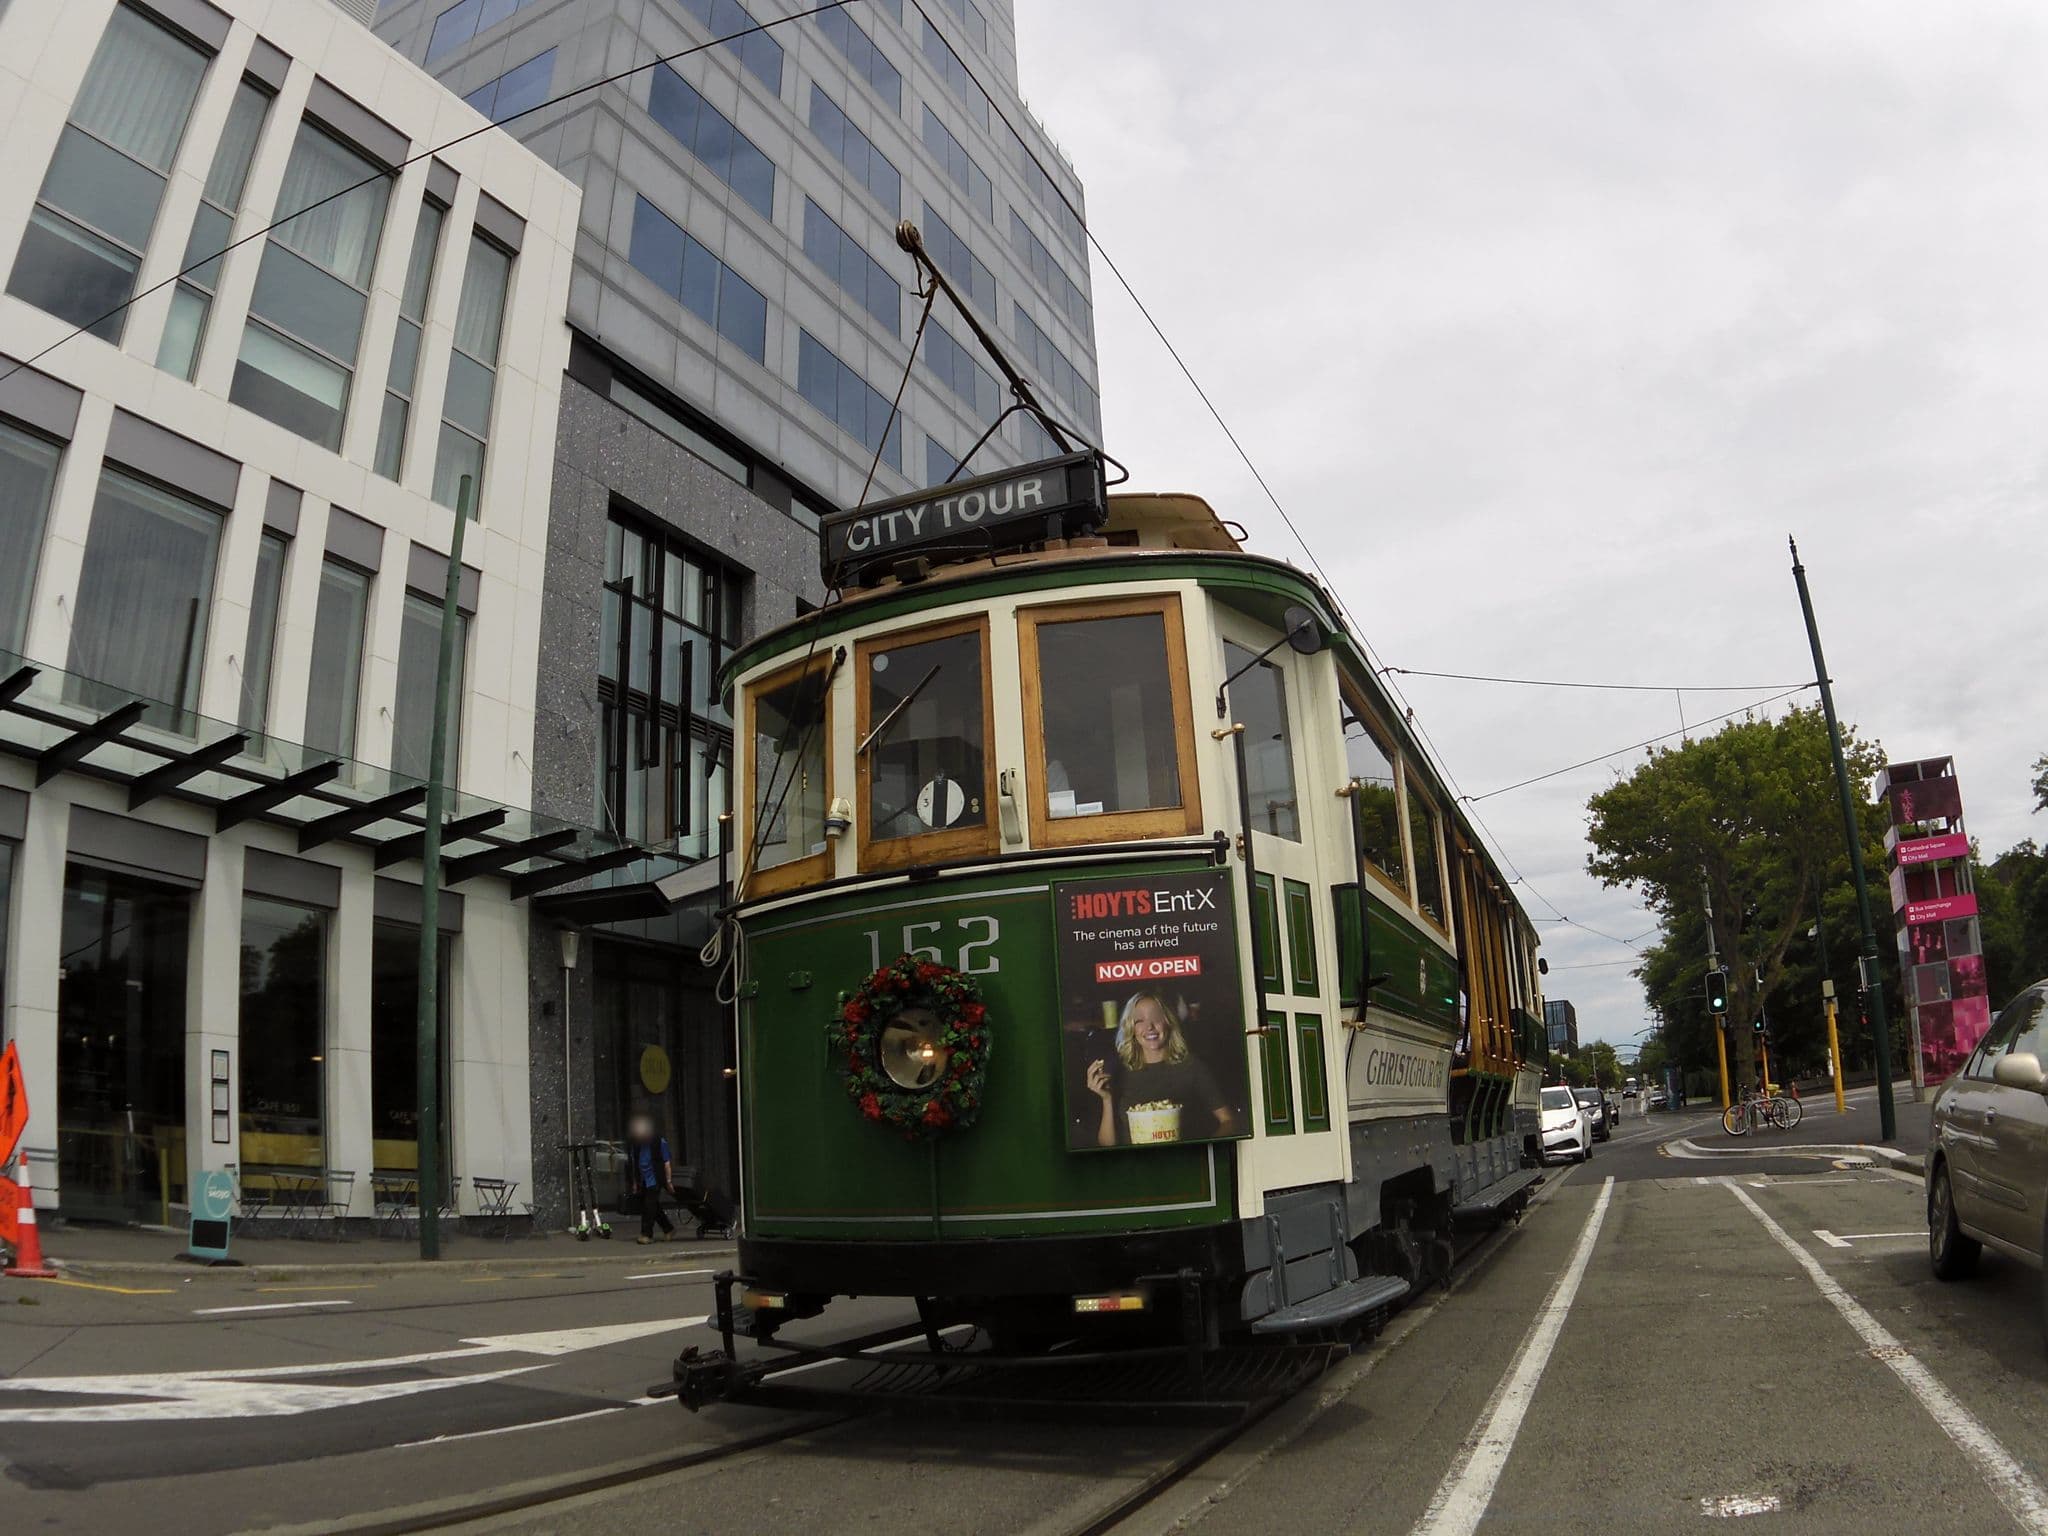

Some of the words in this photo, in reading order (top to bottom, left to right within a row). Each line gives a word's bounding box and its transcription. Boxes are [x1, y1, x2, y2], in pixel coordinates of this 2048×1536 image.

[847, 504, 928, 551] CITY
[935, 477, 1044, 527] TOUR
[1907, 842, 1929, 852] Cathedral
[1930, 842, 1945, 850] Square
[1074, 889, 1152, 919] HOYTS
[1154, 888, 1216, 913] EntX
[1924, 902, 1952, 911] Interchange
[1073, 930, 1096, 941] The
[1099, 926, 1142, 939] cinema
[1145, 923, 1157, 936] of
[1160, 923, 1180, 935] the
[1183, 921, 1218, 933] future
[864, 915, 999, 974] 152
[1114, 940, 1135, 951] has
[1138, 936, 1179, 949] arrived
[1099, 963, 1143, 979] NOW
[1149, 958, 1198, 974] OPEN
[1367, 1049, 1444, 1088] CHRISTCHURCH
[1152, 1129, 1176, 1139] HOYTS
